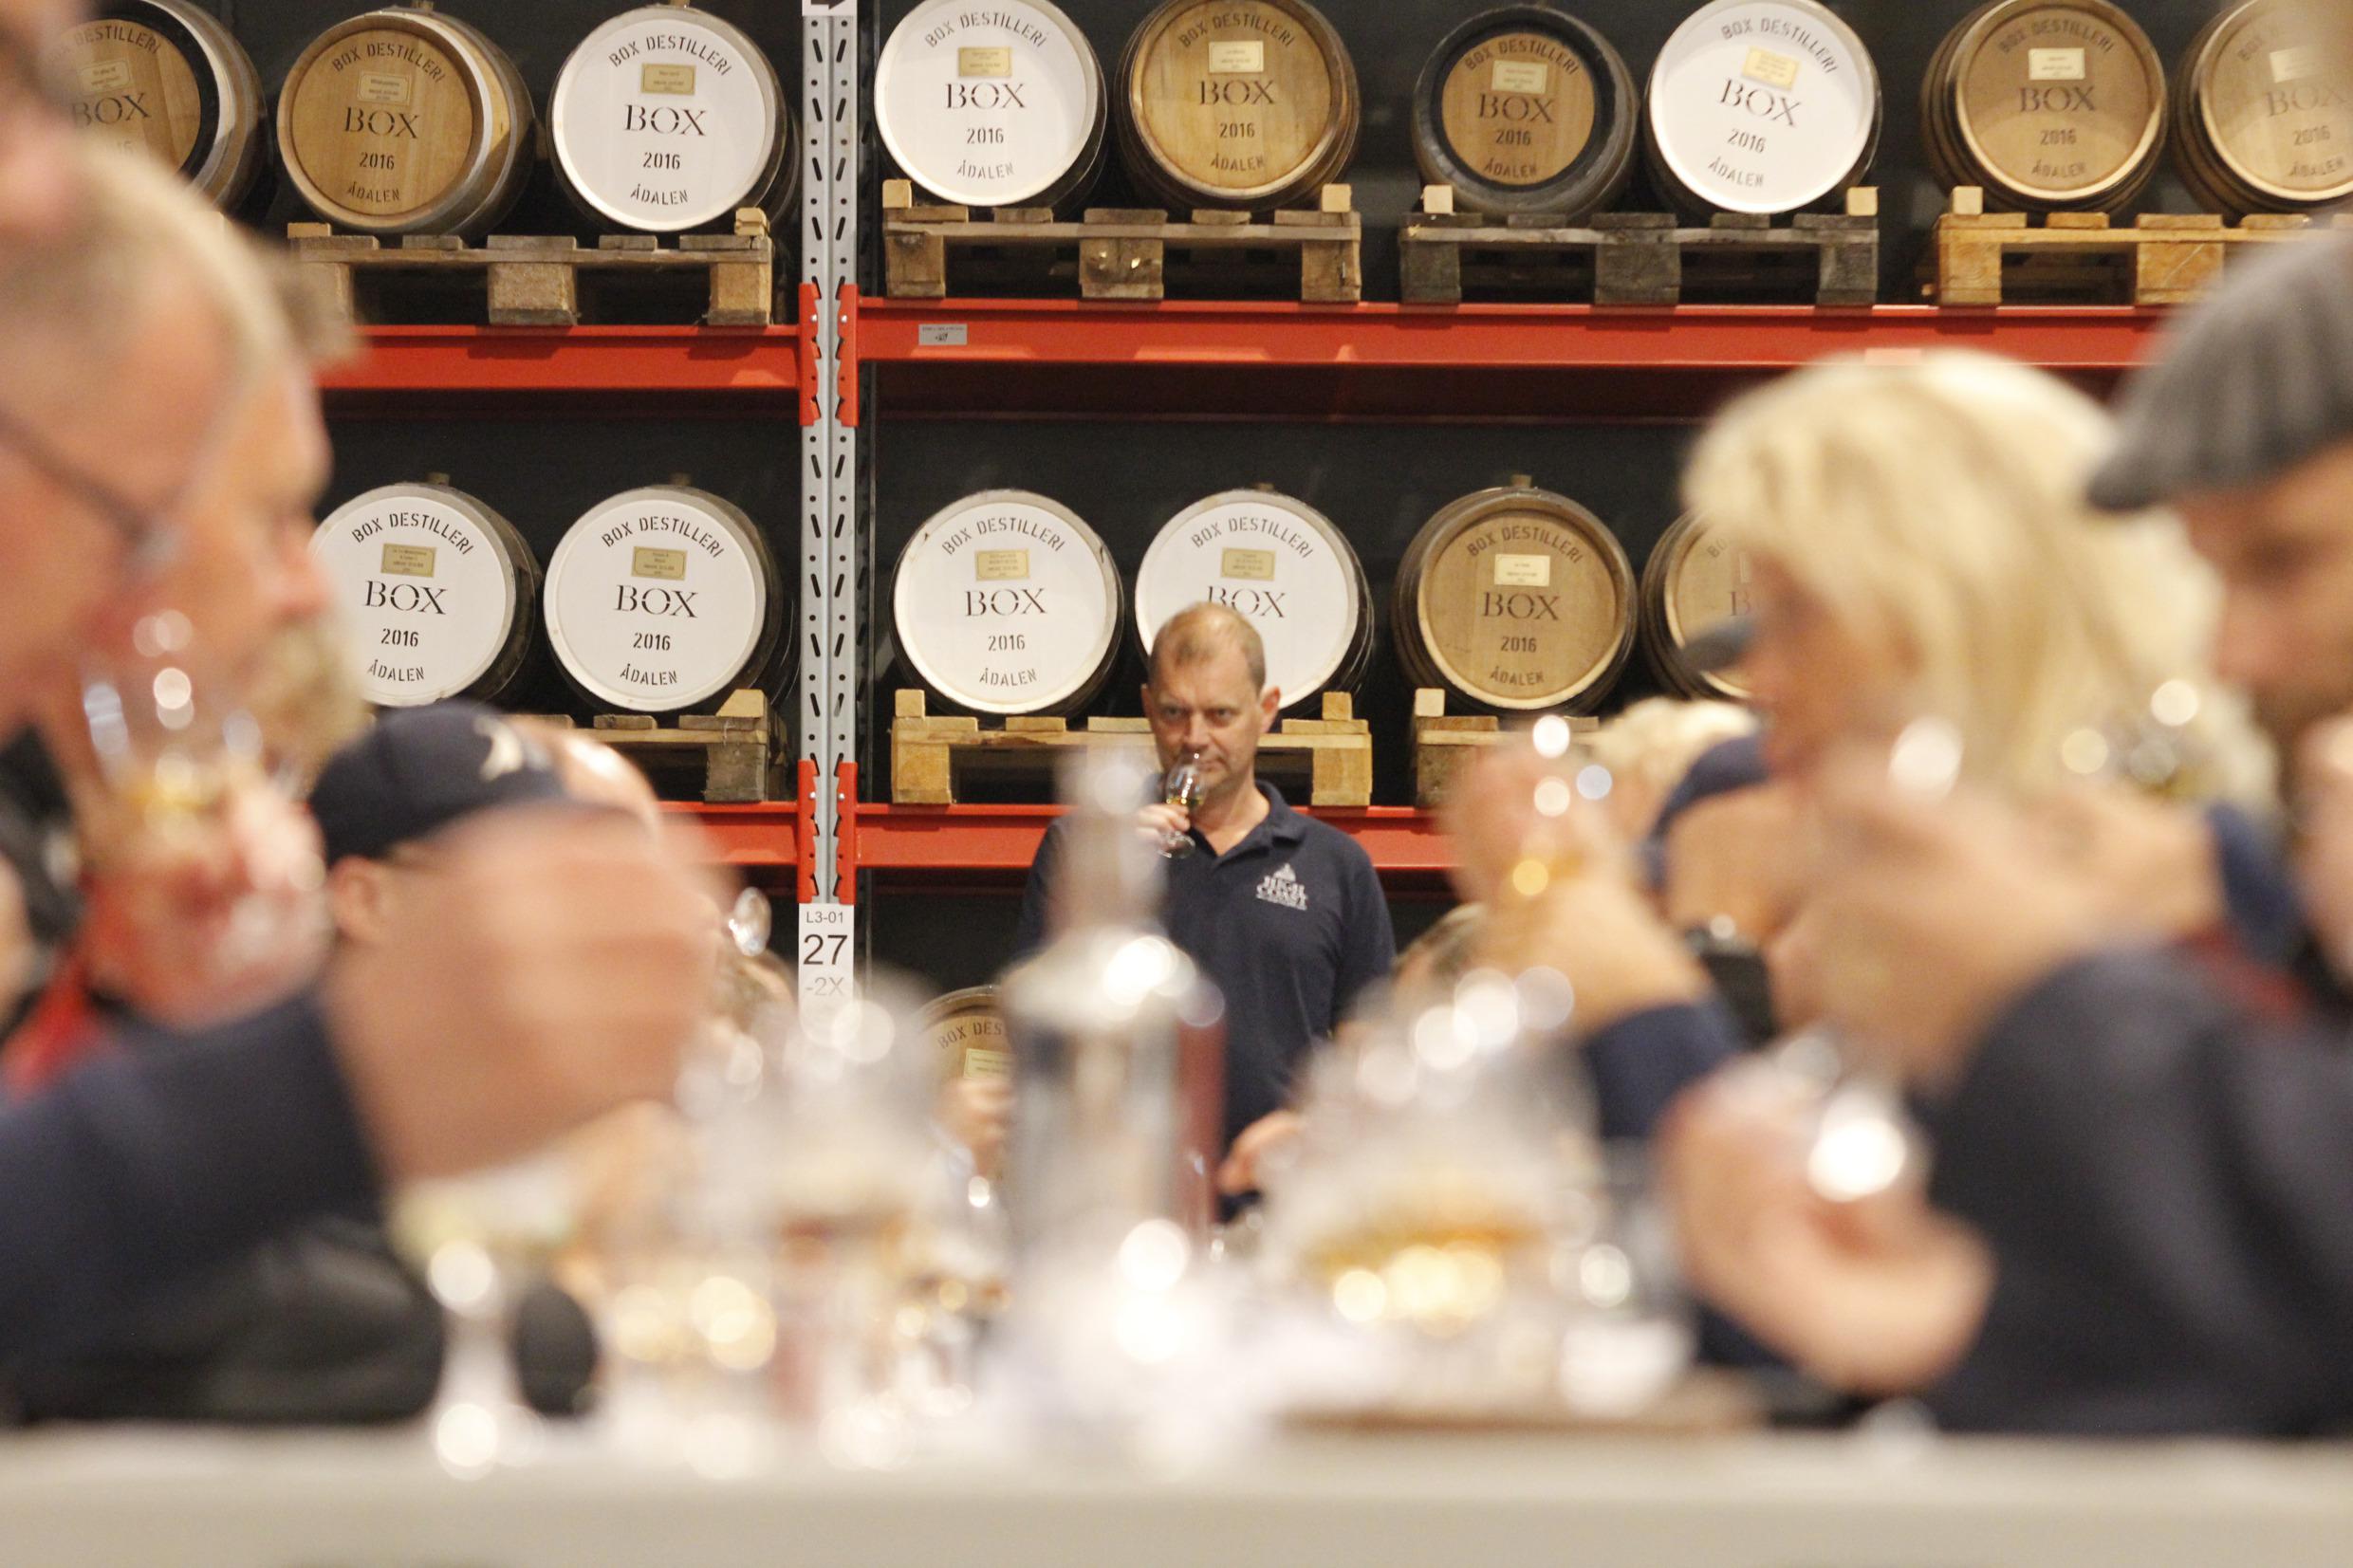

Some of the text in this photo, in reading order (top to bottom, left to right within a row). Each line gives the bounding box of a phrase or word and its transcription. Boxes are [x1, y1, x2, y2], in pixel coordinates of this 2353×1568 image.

[924, 12, 1047, 47] BOX DESTILLERI
[1178, 12, 1296, 47] BOX DESTILLERI
[608, 34, 732, 76] BOX DESTILLERI
[1465, 39, 1579, 75] BOX DESTILLERI
[1720, 18, 1753, 40] BOX
[1760, 17, 1838, 73] DESTILLERI
[332, 43, 445, 83] BOX DESTILLERI
[946, 83, 1026, 110] BOX
[1198, 80, 1275, 106] BOX
[1478, 93, 1556, 123] BOX
[1718, 77, 1802, 128] BOX
[2019, 85, 2097, 112] BOX
[70, 93, 152, 129] BOX
[344, 106, 419, 139] BOX
[624, 104, 707, 137] BOX
[967, 127, 1004, 144] 2016
[1219, 122, 1255, 138] 2016
[1495, 129, 1532, 146] 2016
[1727, 128, 1767, 154] 2016
[2040, 129, 2077, 146] 2016
[359, 152, 395, 171] 2016
[643, 152, 681, 170] 2016
[351, 512, 474, 555] BOX DESTILLERI
[601, 516, 725, 558] BOX DESTILLERI
[941, 517, 1066, 555] BOX DESTILLERI
[1191, 516, 1314, 559] BOX DESTILLERI
[1466, 526, 1584, 563] BOX DESTILLERI
[363, 580, 449, 615] BOX
[614, 584, 699, 618] BOX
[964, 588, 1047, 618] BOX
[1207, 585, 1287, 618] BOX
[1483, 591, 1562, 621] BOX
[380, 628, 419, 647] 2016
[633, 632, 671, 652] 2016
[988, 635, 1026, 652] 2016
[1500, 636, 1537, 654] 2016
[367, 658, 425, 682] ÅDALEN
[620, 663, 677, 686] ÅDALEN
[979, 668, 1037, 687] ÅDALEN
[1490, 666, 1545, 687] ÅDALEN
[806, 911, 844, 924] L3-01
[803, 933, 848, 966] 27
[937, 1025, 967, 1049] BOX
